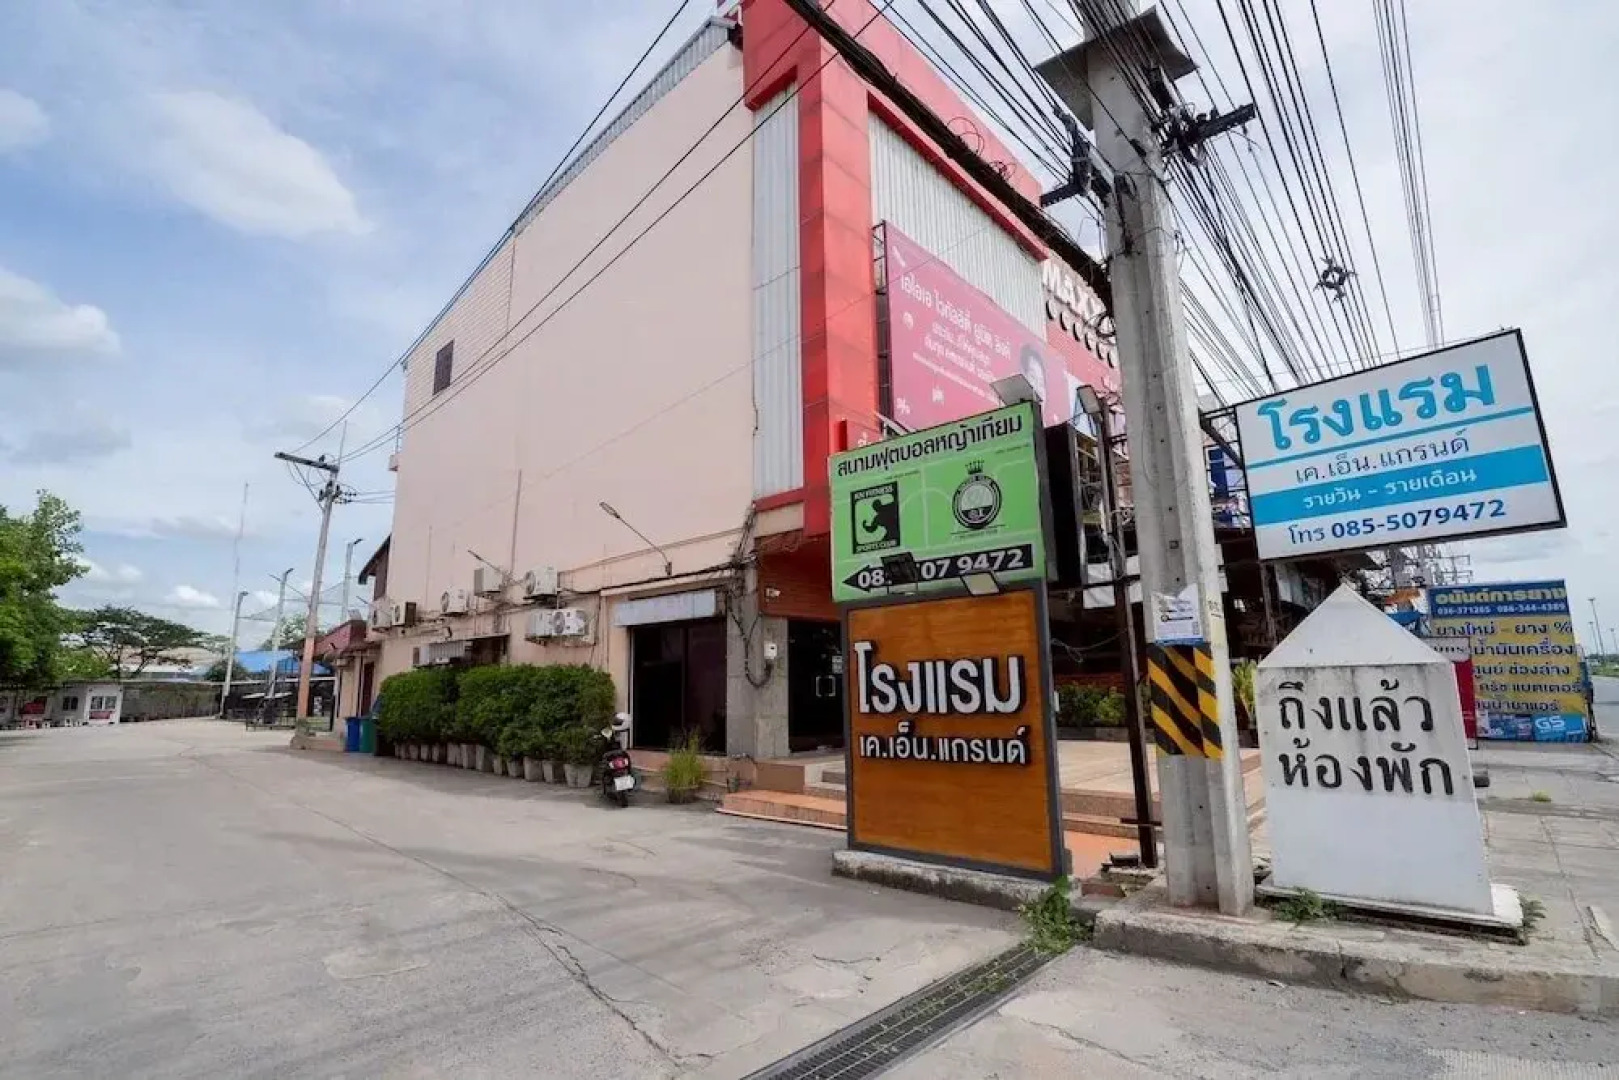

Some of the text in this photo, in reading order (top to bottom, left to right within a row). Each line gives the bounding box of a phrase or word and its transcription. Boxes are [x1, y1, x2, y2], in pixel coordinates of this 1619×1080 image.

[1258, 364, 1495, 451] โรงแรม
[838, 414, 1023, 477] สนามฟุตบอลหญ้าเทียม
[1296, 428, 1469, 483] เค.เอ็น.แกรนด์
[1303, 487, 1361, 510] รายวัน
[1384, 466, 1477, 494] รายเดือน
[1288, 498, 1506, 545] โทร 085-5079472
[854, 640, 1025, 715] โรงแรม
[1278, 679, 1434, 732] ถึงแล้ว
[1534, 715, 1566, 730] GS
[859, 721, 1027, 765] เค.เอ็น.แกรนด์
[1278, 737, 1454, 796] ห้องพัก
